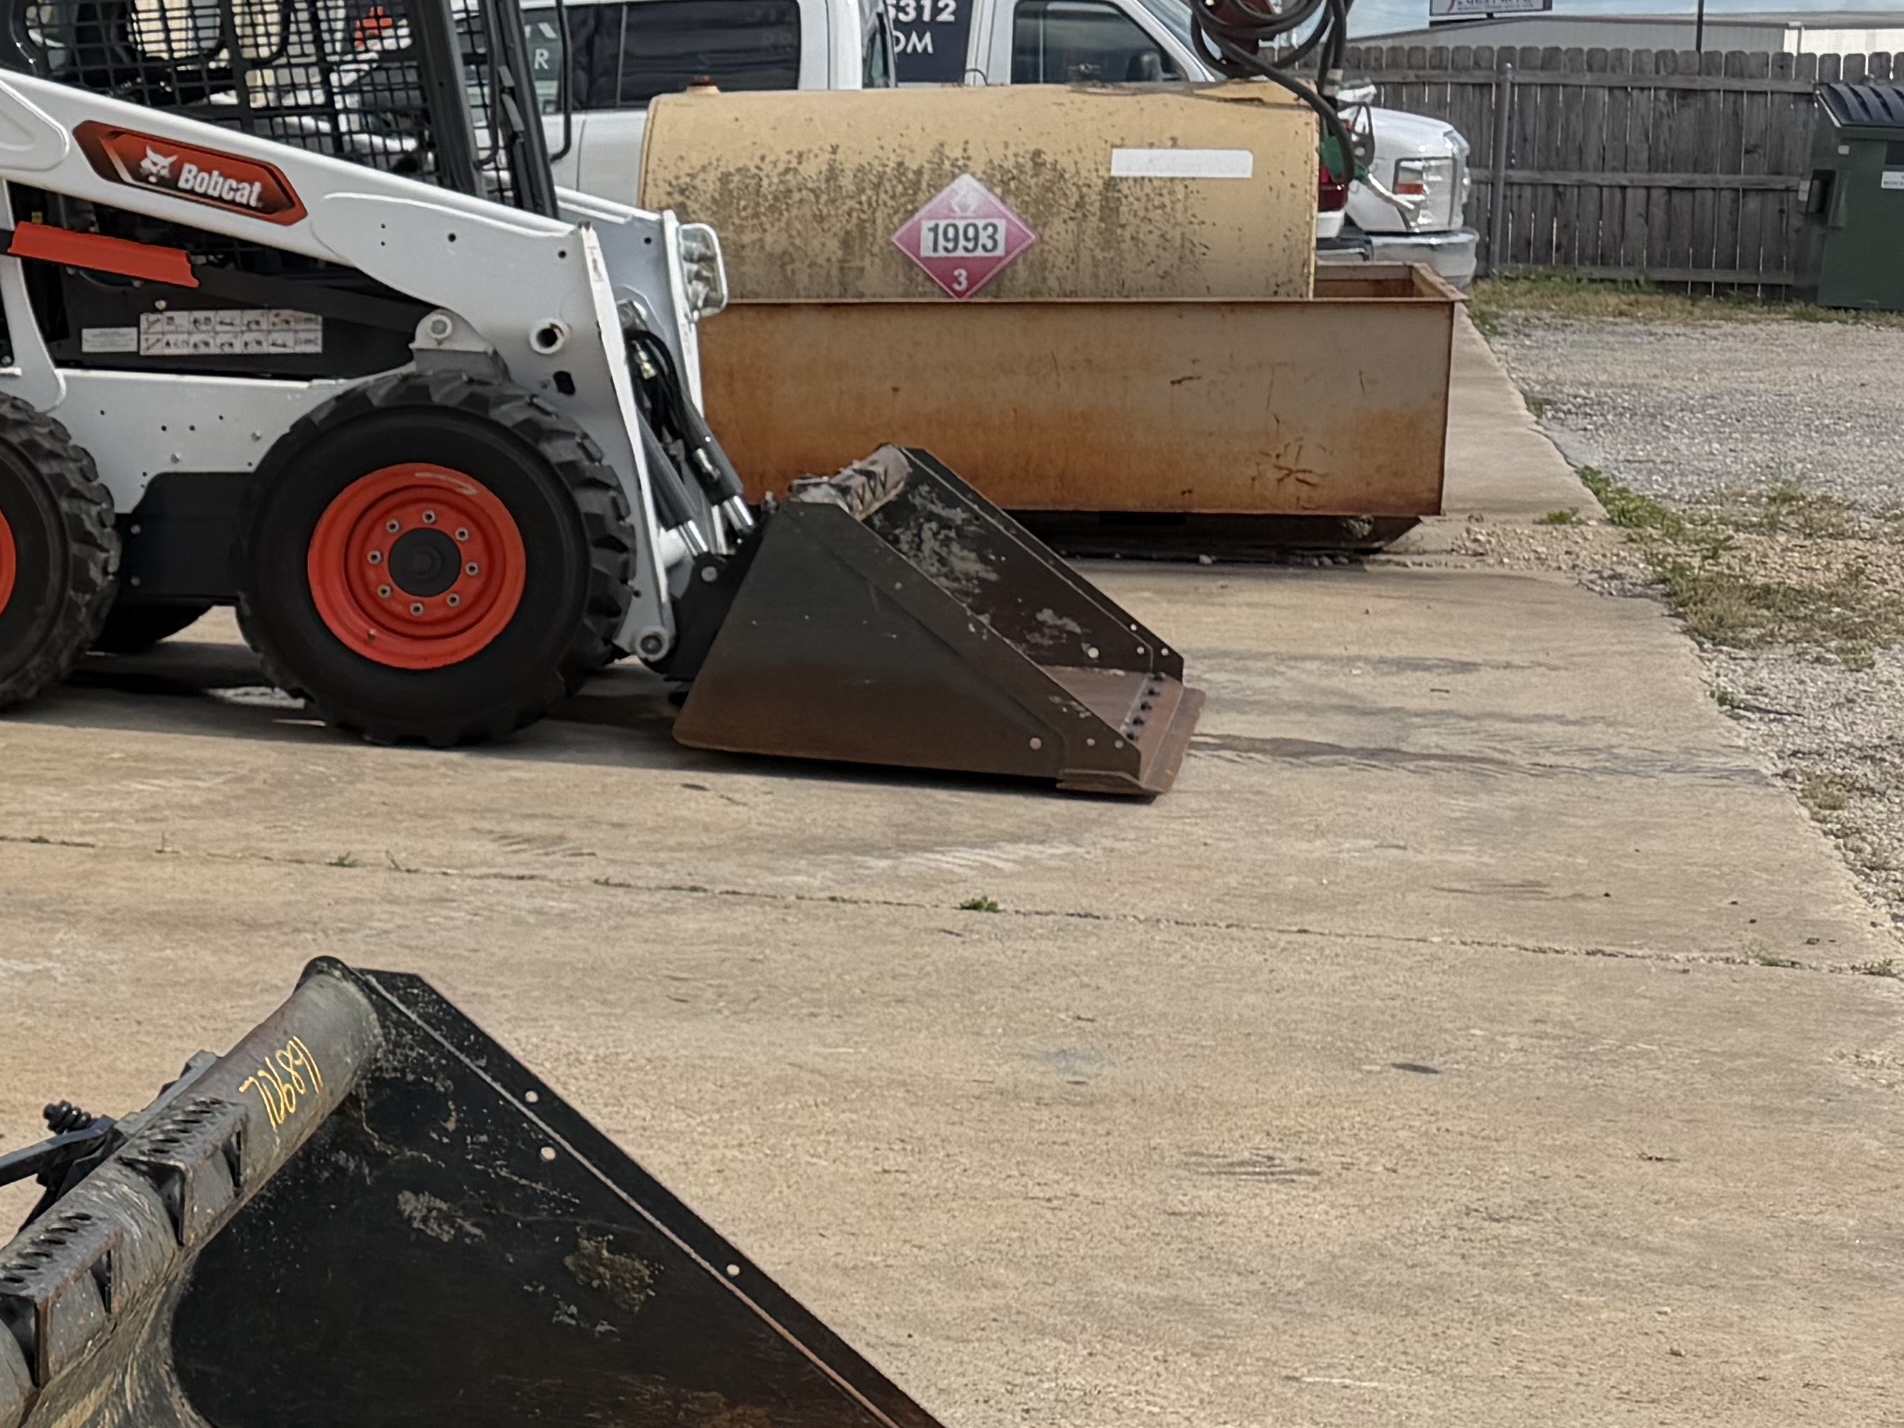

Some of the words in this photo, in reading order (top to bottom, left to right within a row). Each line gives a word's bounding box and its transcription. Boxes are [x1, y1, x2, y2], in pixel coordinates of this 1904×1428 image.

[177, 163, 262, 208] Bobcat
[927, 222, 999, 254] 1993
[952, 268, 968, 292] 3
